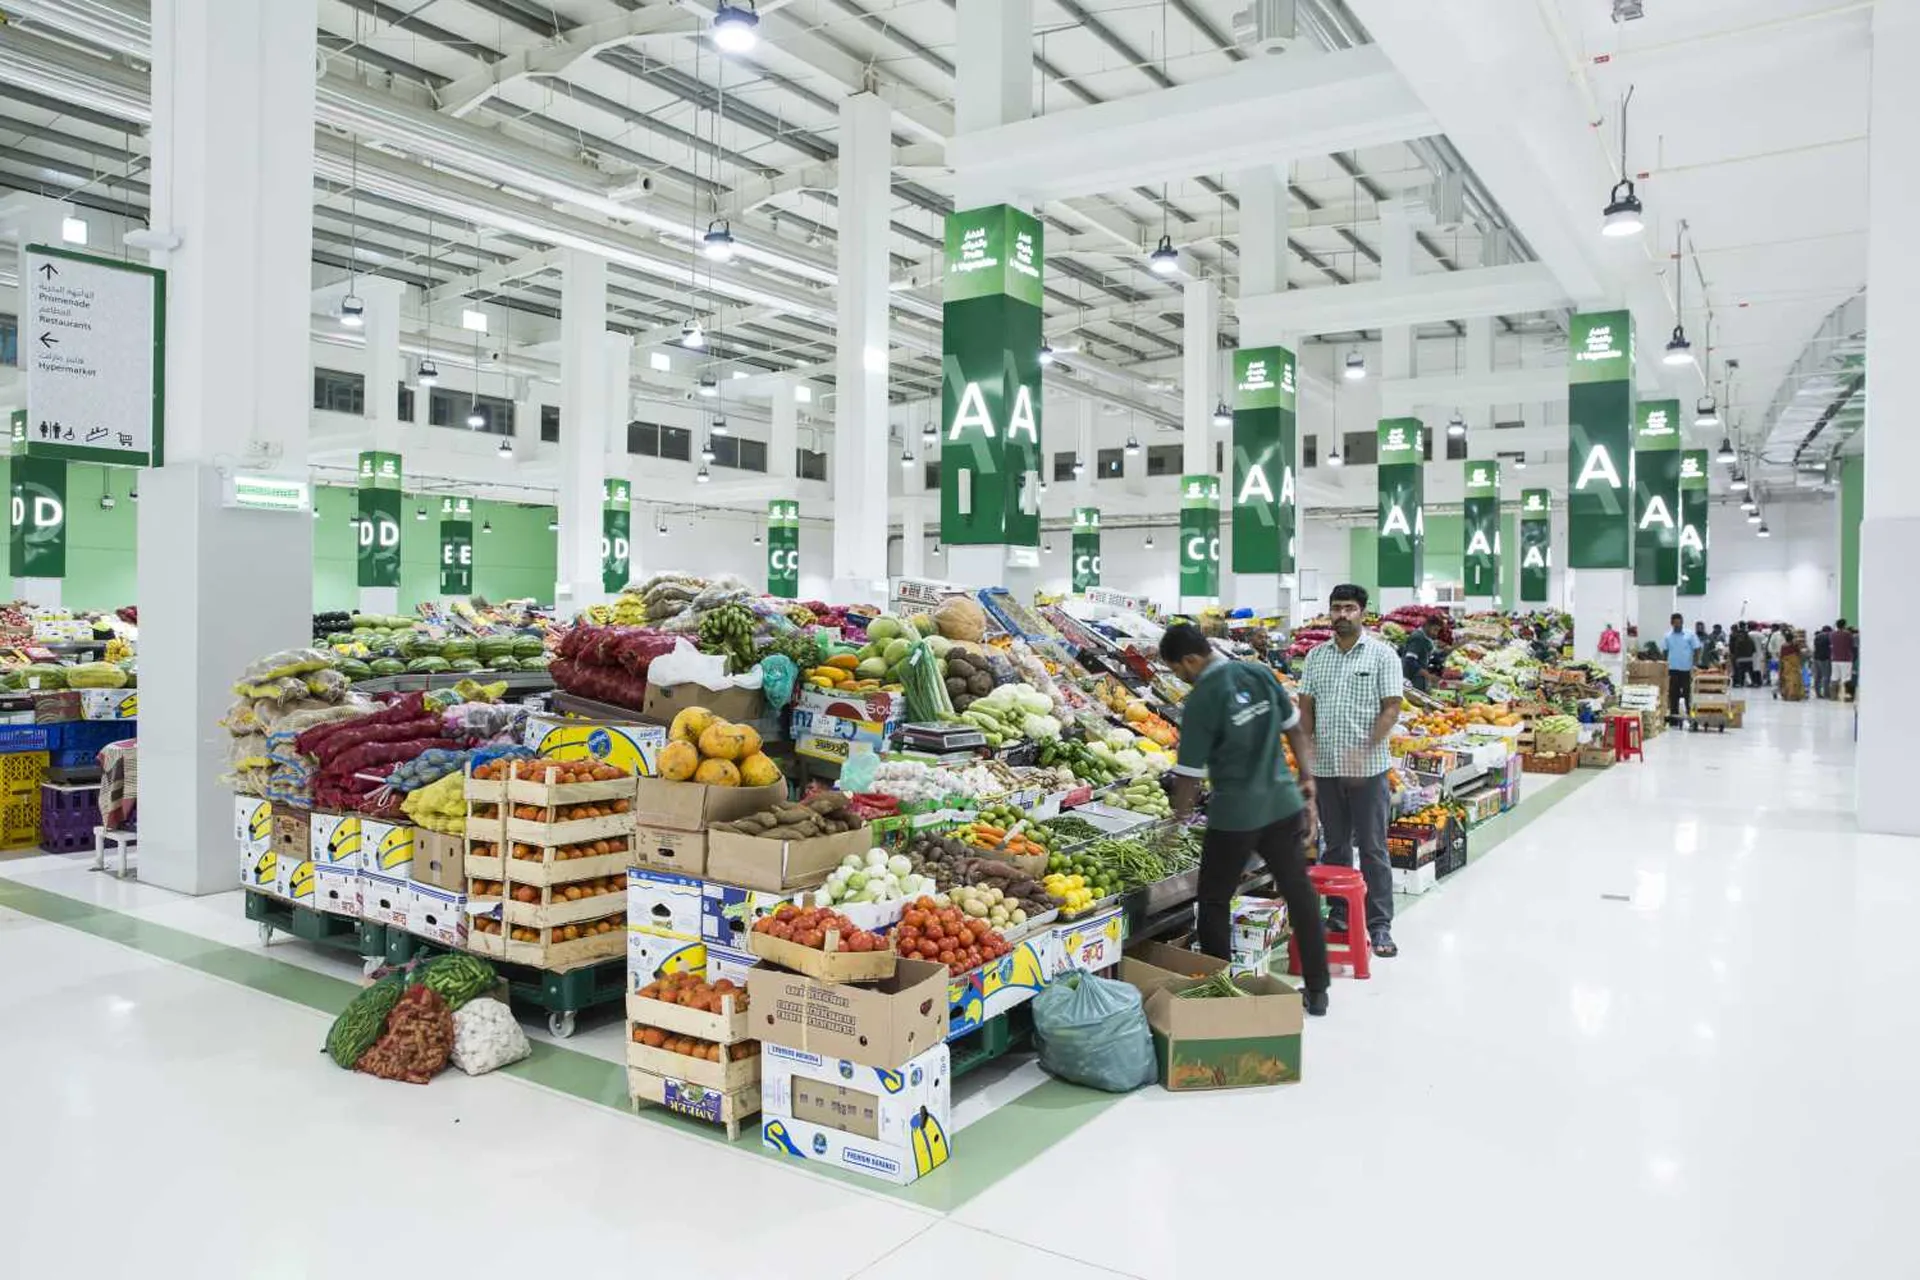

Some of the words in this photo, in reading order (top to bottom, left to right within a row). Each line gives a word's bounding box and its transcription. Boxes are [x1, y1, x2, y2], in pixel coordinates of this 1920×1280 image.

[39, 292, 90, 309] Promenade
[39, 315, 92, 331] Restaurants
[38, 361, 96, 377] Hypermarket
[949, 382, 996, 440] A
[1008, 384, 1037, 443] A
[1575, 444, 1622, 490] A
[1238, 464, 1274, 503] A
[12, 497, 24, 526] D
[34, 496, 62, 526] D
[1382, 505, 1411, 536] A
[1639, 495, 1674, 529] A
[360, 521, 374, 546] D
[380, 521, 399, 546] D
[1467, 530, 1492, 555] A
[1679, 524, 1703, 551] A
[444, 544, 452, 564] E
[460, 545, 472, 565] E
[614, 537, 629, 559] D
[771, 550, 784, 569] C
[1188, 536, 1205, 560] C
[1523, 546, 1544, 568] A
[1076, 555, 1090, 574] C
